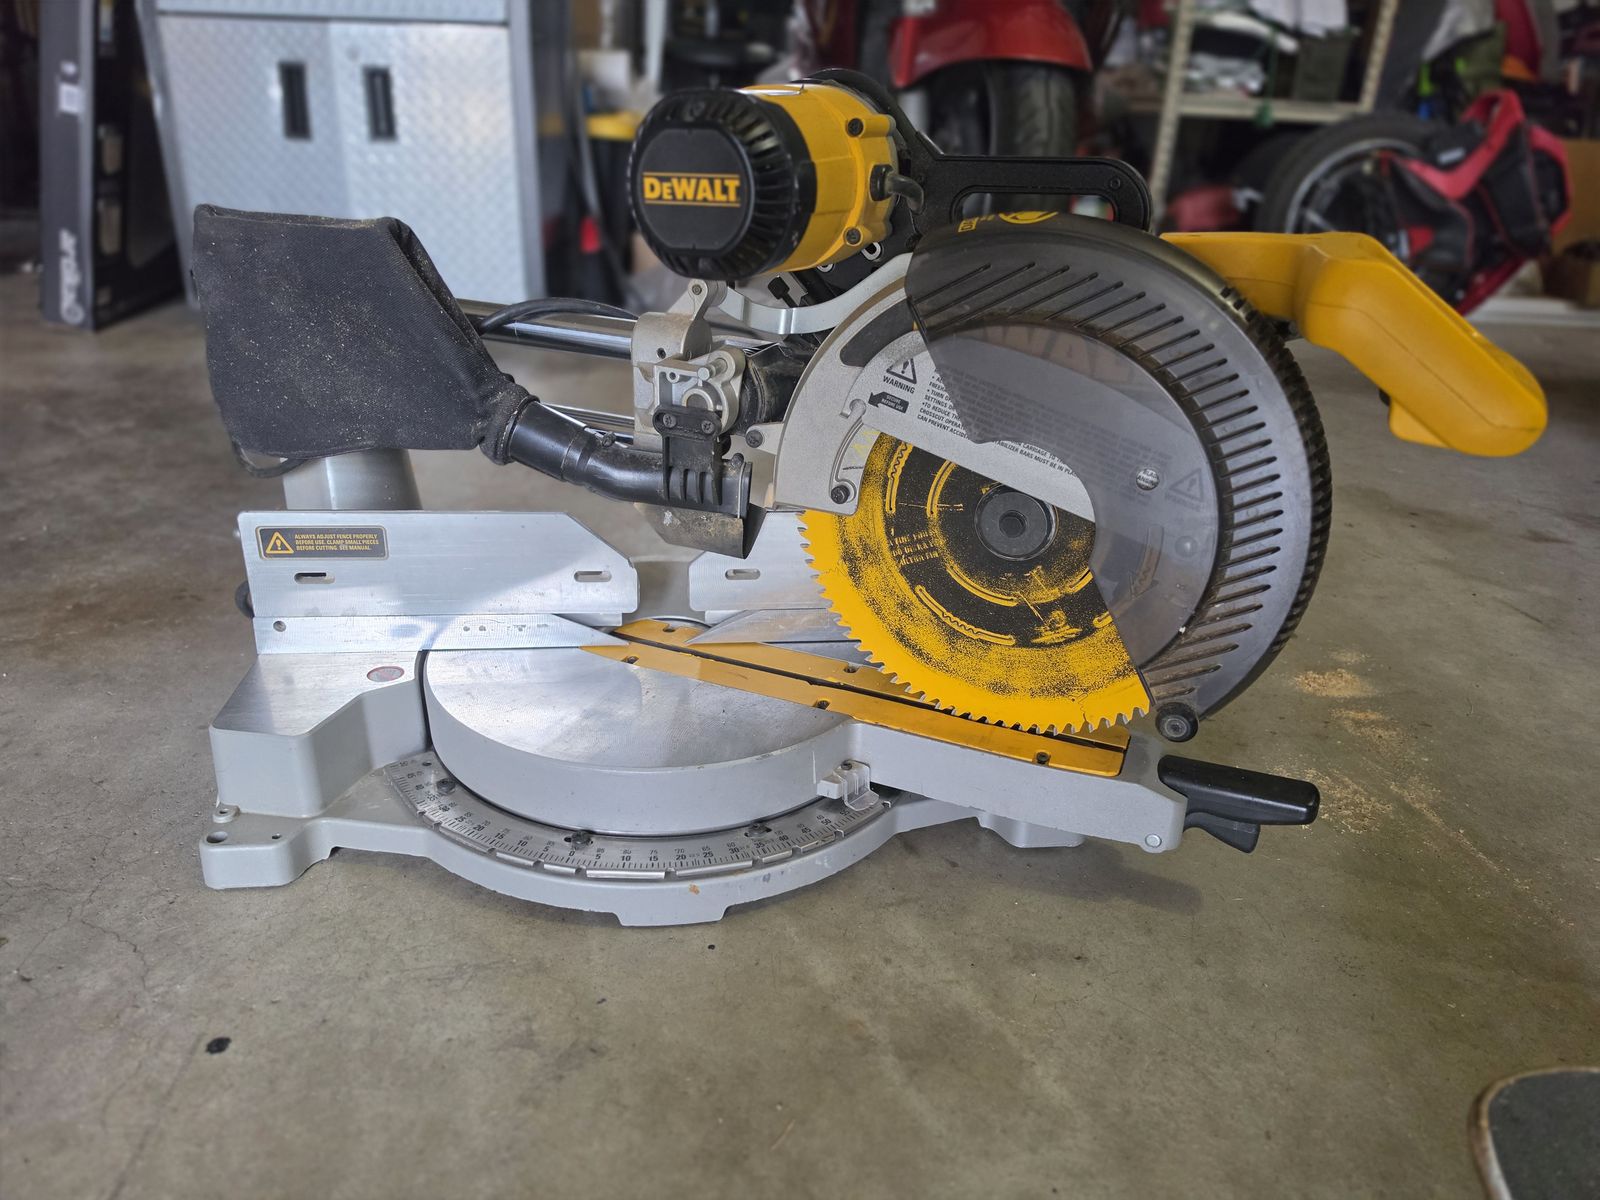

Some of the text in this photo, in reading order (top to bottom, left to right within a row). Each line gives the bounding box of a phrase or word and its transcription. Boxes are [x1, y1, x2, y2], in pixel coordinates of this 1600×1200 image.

[883, 375, 915, 394] WARNING
[924, 394, 947, 407] SETTINGS
[931, 389, 944, 399] TURN
[919, 406, 945, 421] CROSSCUT
[931, 405, 951, 417] REDUCE
[917, 413, 927, 422] CAN
[927, 418, 949, 431] PREVENT
[1019, 449, 1033, 459] BARS
[1033, 455, 1049, 465] MUST
[1022, 443, 1047, 456] CARRIAGE
[473, 824, 485, 832] 20
[495, 832, 505, 840] 15
[517, 839, 528, 847] 10
[754, 841, 766, 849] 35
